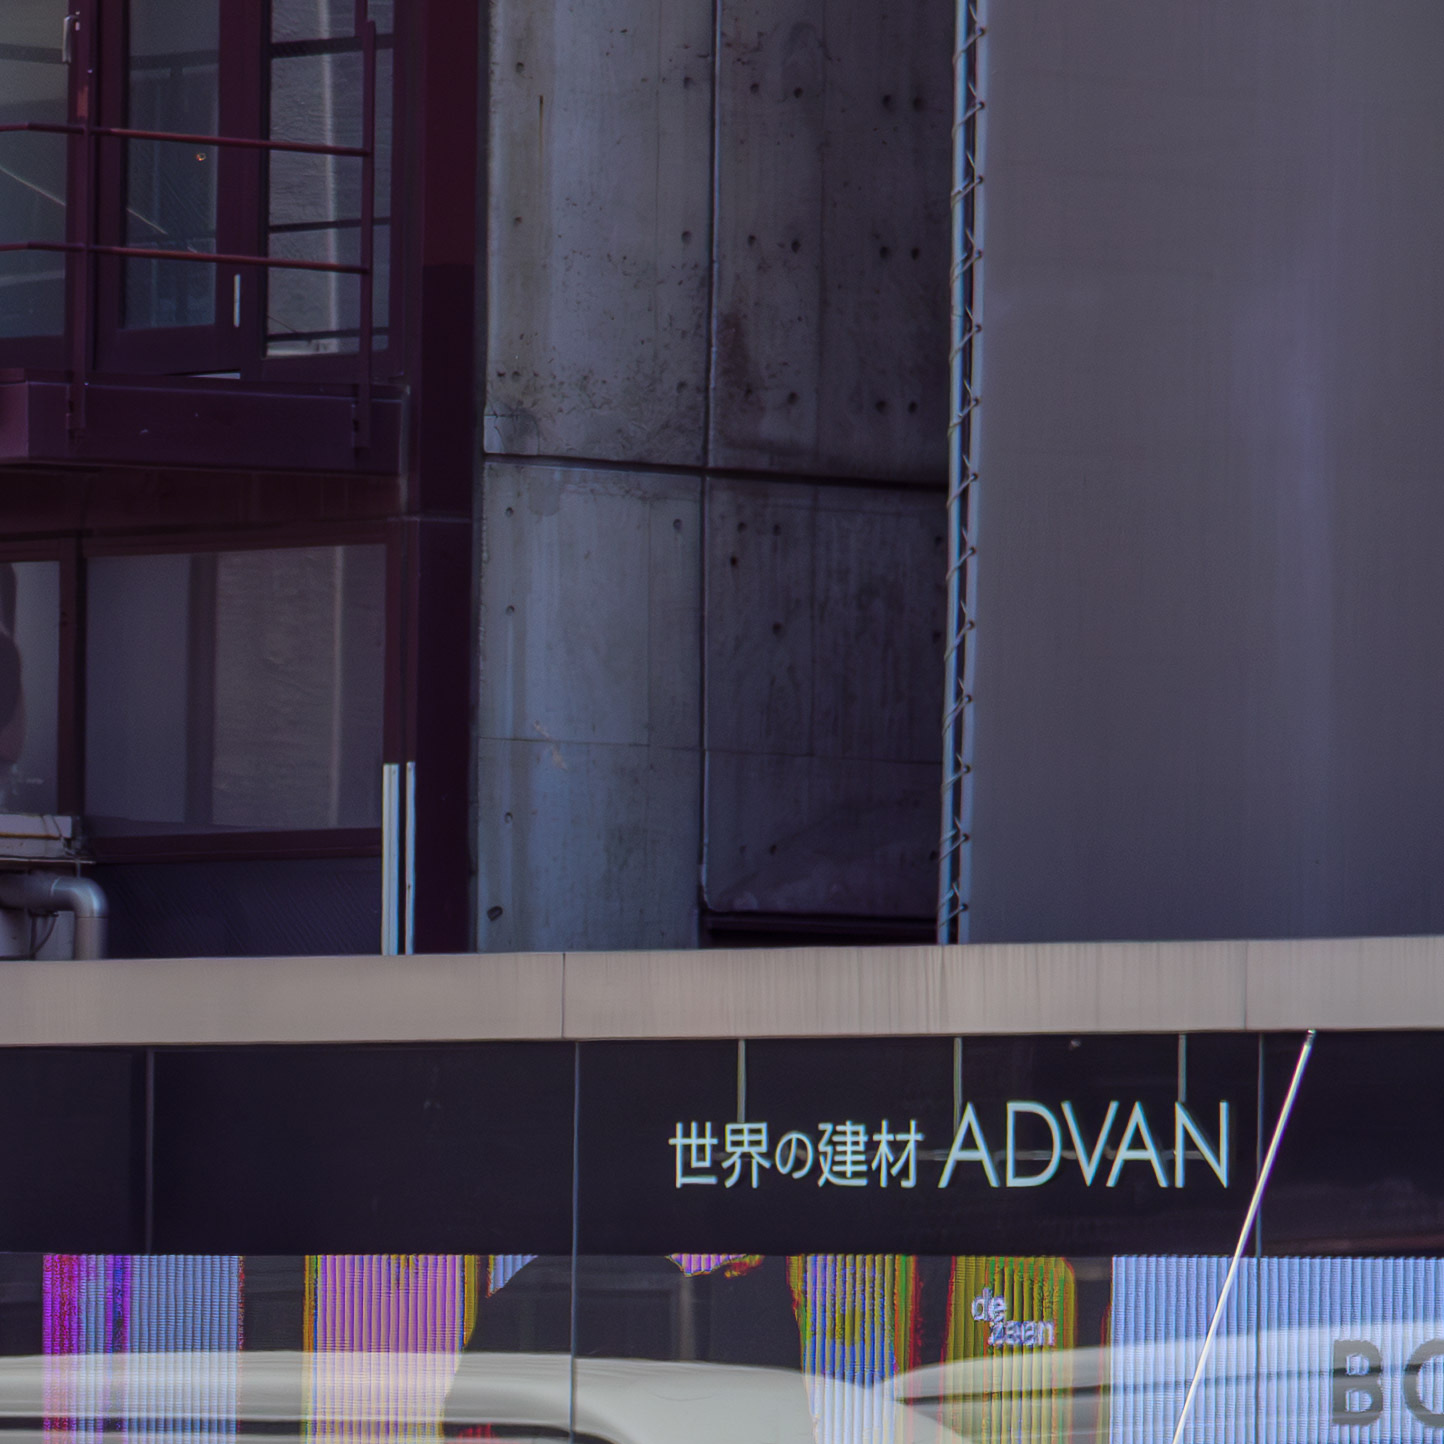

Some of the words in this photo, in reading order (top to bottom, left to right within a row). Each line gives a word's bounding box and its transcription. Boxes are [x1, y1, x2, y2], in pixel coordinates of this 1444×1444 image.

[668, 1120, 924, 1189] 世界の建材
[937, 1101, 1229, 1189] ADVAN
